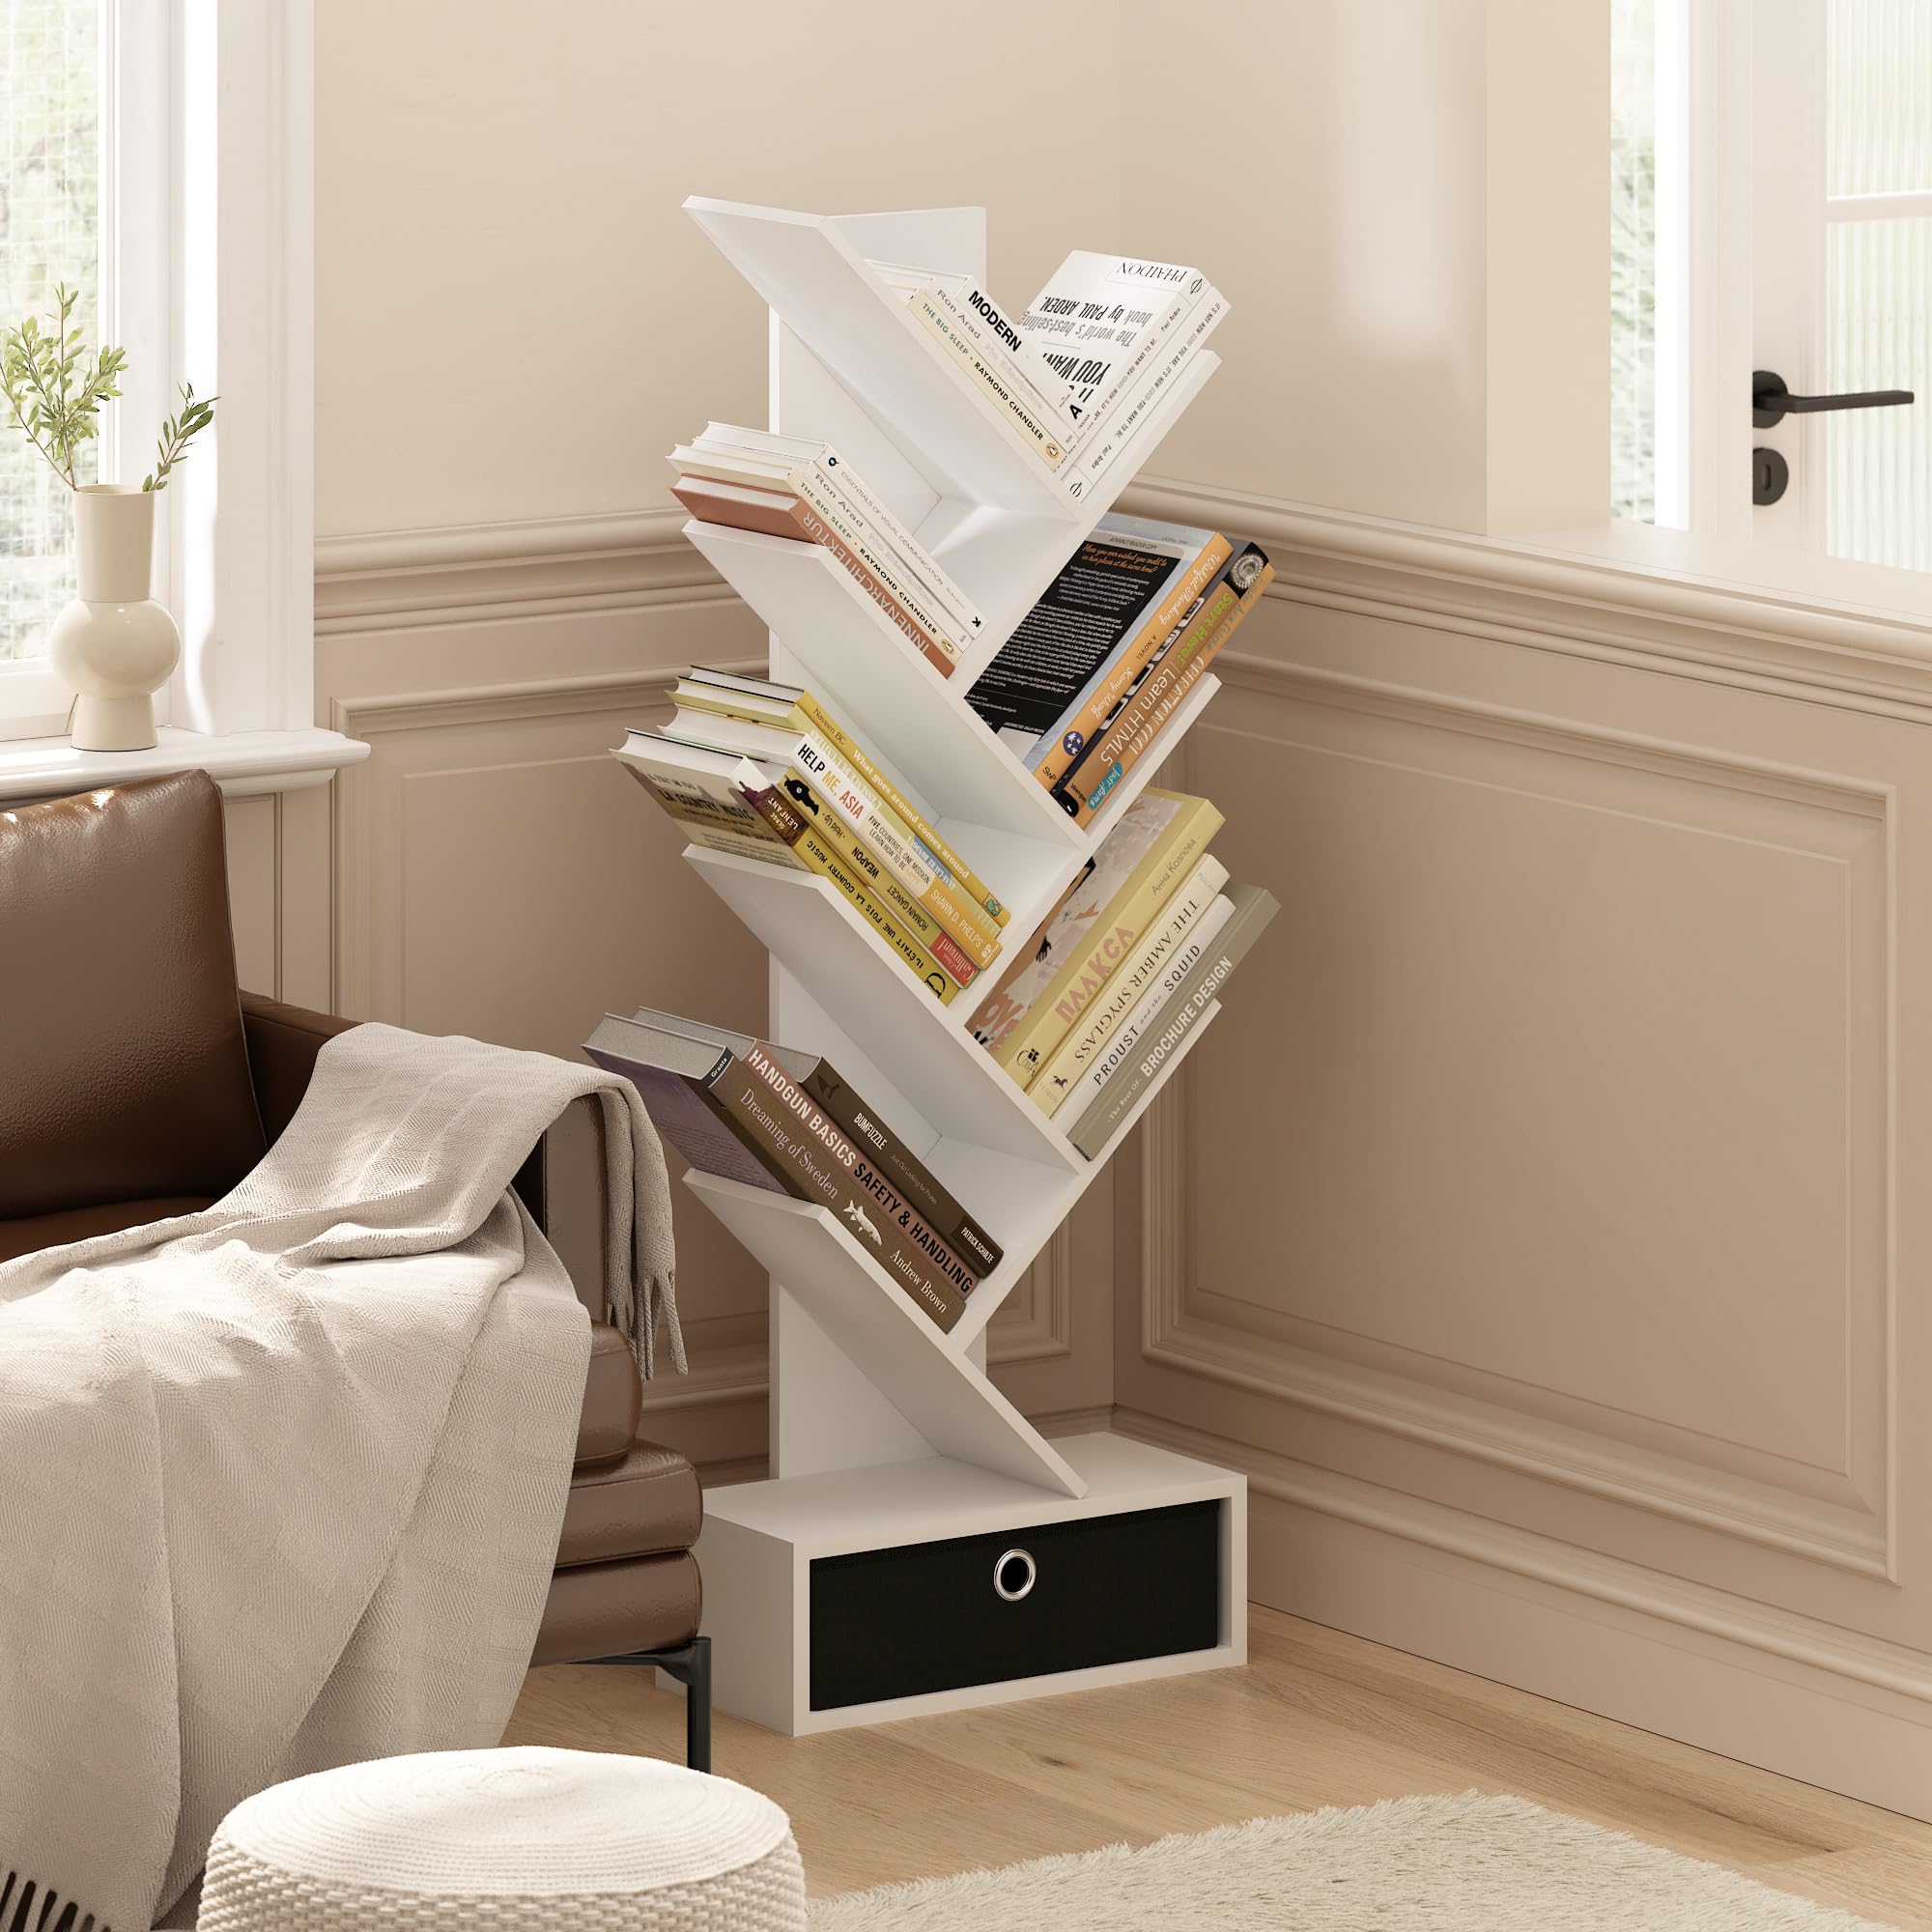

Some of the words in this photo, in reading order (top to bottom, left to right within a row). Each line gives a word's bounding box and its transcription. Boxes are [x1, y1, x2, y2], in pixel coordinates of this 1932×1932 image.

[1116, 262, 1187, 282] PHAIDON
[937, 289, 957, 313] Ron
[958, 314, 981, 339] Arad
[968, 290, 1023, 353] MODERN
[1078, 302, 1109, 321] PAUL
[1108, 304, 1124, 324] by
[1123, 310, 1153, 327] book
[1075, 324, 1115, 340] world's
[1116, 330, 1136, 347] The
[923, 303, 936, 319] THE
[936, 318, 949, 333] BIG
[949, 333, 969, 355] SLEEP
[974, 361, 1009, 401] RAYMOND
[1009, 401, 1043, 440] CHANDLER
[1071, 360, 1111, 385] YOU
[815, 473, 837, 498] Ron
[838, 501, 864, 528] Arad
[800, 481, 815, 499] THE
[815, 499, 830, 515] BIG
[831, 516, 852, 539] SLEEP
[859, 548, 897, 590] RAYMOND
[898, 591, 937, 635] CHANDLER
[1190, 553, 1221, 590] Wishful
[803, 511, 930, 654] INNENARCHITEKTUR
[1159, 586, 1195, 626] Thinking
[1204, 591, 1233, 628] Start
[1136, 639, 1153, 661] NOVEL
[1140, 668, 1177, 710] Learn
[1100, 709, 1145, 767] HTML5
[797, 743, 826, 773] HELP
[821, 770, 841, 796] ME,
[838, 790, 865, 819] ASIA
[812, 707, 836, 734] Naveen
[835, 731, 847, 745] BC
[853, 749, 874, 775] What
[871, 774, 892, 794] goes
[891, 793, 920, 824] around
[917, 822, 943, 851] comes
[941, 849, 970, 879] around
[768, 797, 799, 831] LENFANT
[770, 811, 785, 830] SERGE
[824, 814, 833, 826] Up
[830, 820, 843, 838] Hold
[807, 840, 828, 865] MUSIC
[868, 815, 881, 830] FIVE
[902, 852, 913, 867] ONE
[869, 829, 887, 847] LEARN
[884, 844, 895, 858] HOW
[894, 854, 900, 864] TO
[898, 860, 908, 871] BE
[828, 864, 855, 894] COUNTRY
[851, 846, 879, 879] WEAPON
[1151, 872, 1171, 895] Анна
[1167, 838, 1197, 873] Козлова
[855, 893, 866, 905] LA
[866, 904, 883, 923] FOIS
[887, 885, 910, 910] GANCET
[883, 923, 896, 939] UNE
[908, 908, 929, 931] ROMAIN
[930, 890, 952, 916] SHAWN
[958, 921, 983, 948] PHELPS
[1172, 900, 1201, 934] THE
[895, 938, 920, 961] ÉTAIT
[917, 958, 924, 969] IL
[936, 938, 976, 981] Gallimard
[1129, 931, 1172, 987] AMBER
[1074, 987, 1132, 1063] SPYGLASS
[1094, 1026, 1139, 1086] PROUST
[1164, 945, 1200, 991] SQUID
[1140, 1004, 1197, 1077] BROCHURE
[1192, 955, 1234, 1008] DESIGN
[711, 1057, 727, 1077] Granta
[740, 1088, 790, 1151] Dreaming
[787, 1145, 806, 1158] of
[798, 1151, 840, 1200] Sweden
[853, 1112, 889, 1151] BUMFUZZLE
[748, 1048, 812, 1120] HANDGUN
[809, 1114, 856, 1167] BASICS
[853, 1162, 901, 1213] SAFETY
[897, 1210, 911, 1228] &
[909, 1222, 973, 1293] HANDLING
[960, 1227, 979, 1249] PATRICK
[975, 1242, 995, 1264] SCHULTE
[890, 1249, 923, 1286] Andrew
[920, 1280, 947, 1314] Brown
